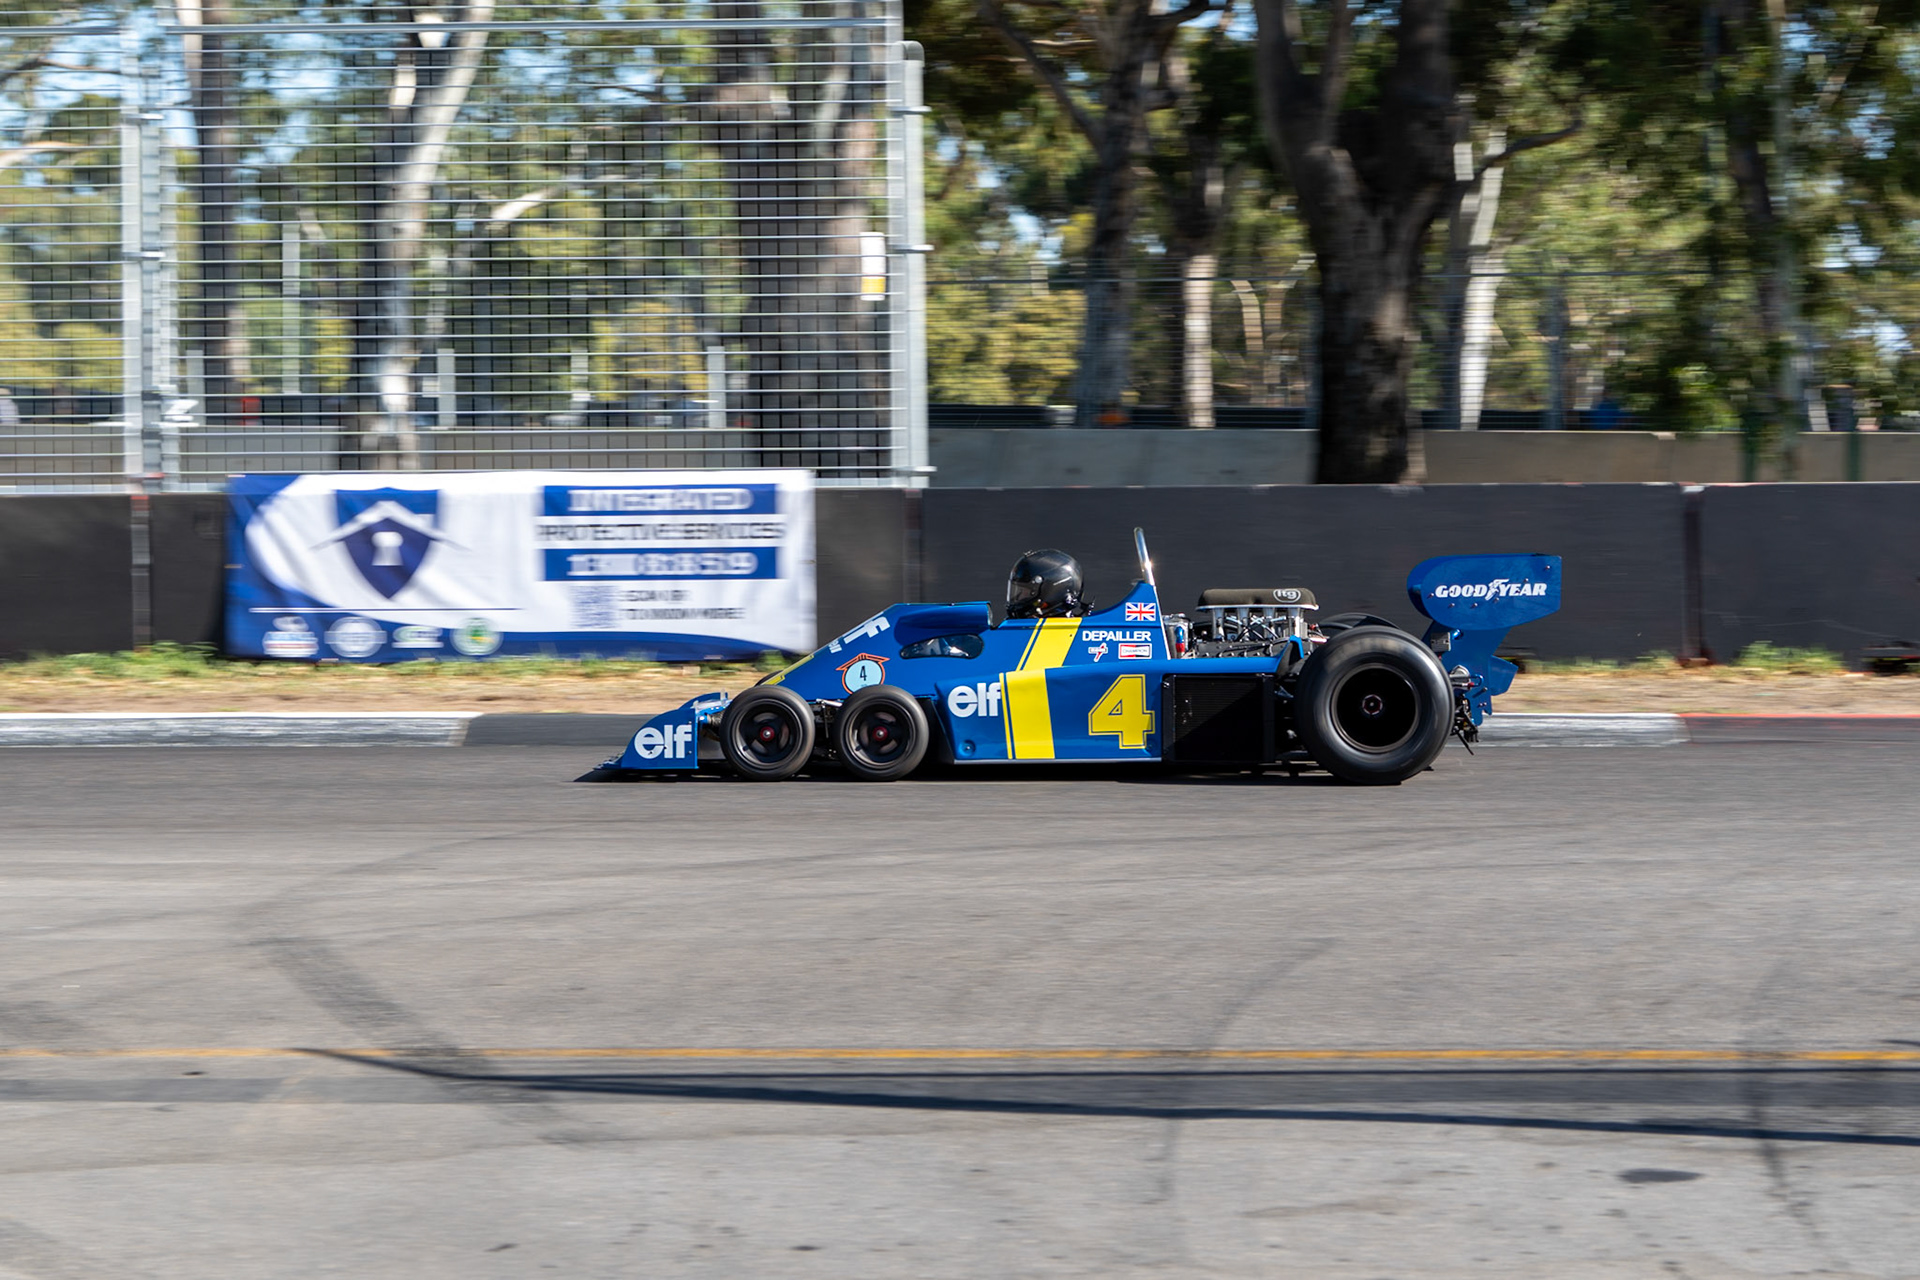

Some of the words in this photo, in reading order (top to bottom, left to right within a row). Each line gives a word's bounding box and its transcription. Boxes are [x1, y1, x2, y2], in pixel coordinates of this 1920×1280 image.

[1435, 581, 1547, 599] GOODYEAR
[1082, 630, 1152, 641] DEPAILLER
[860, 665, 867, 681] 4
[948, 682, 1001, 718] elf
[1088, 674, 1155, 749] 4
[634, 726, 692, 759] elf
